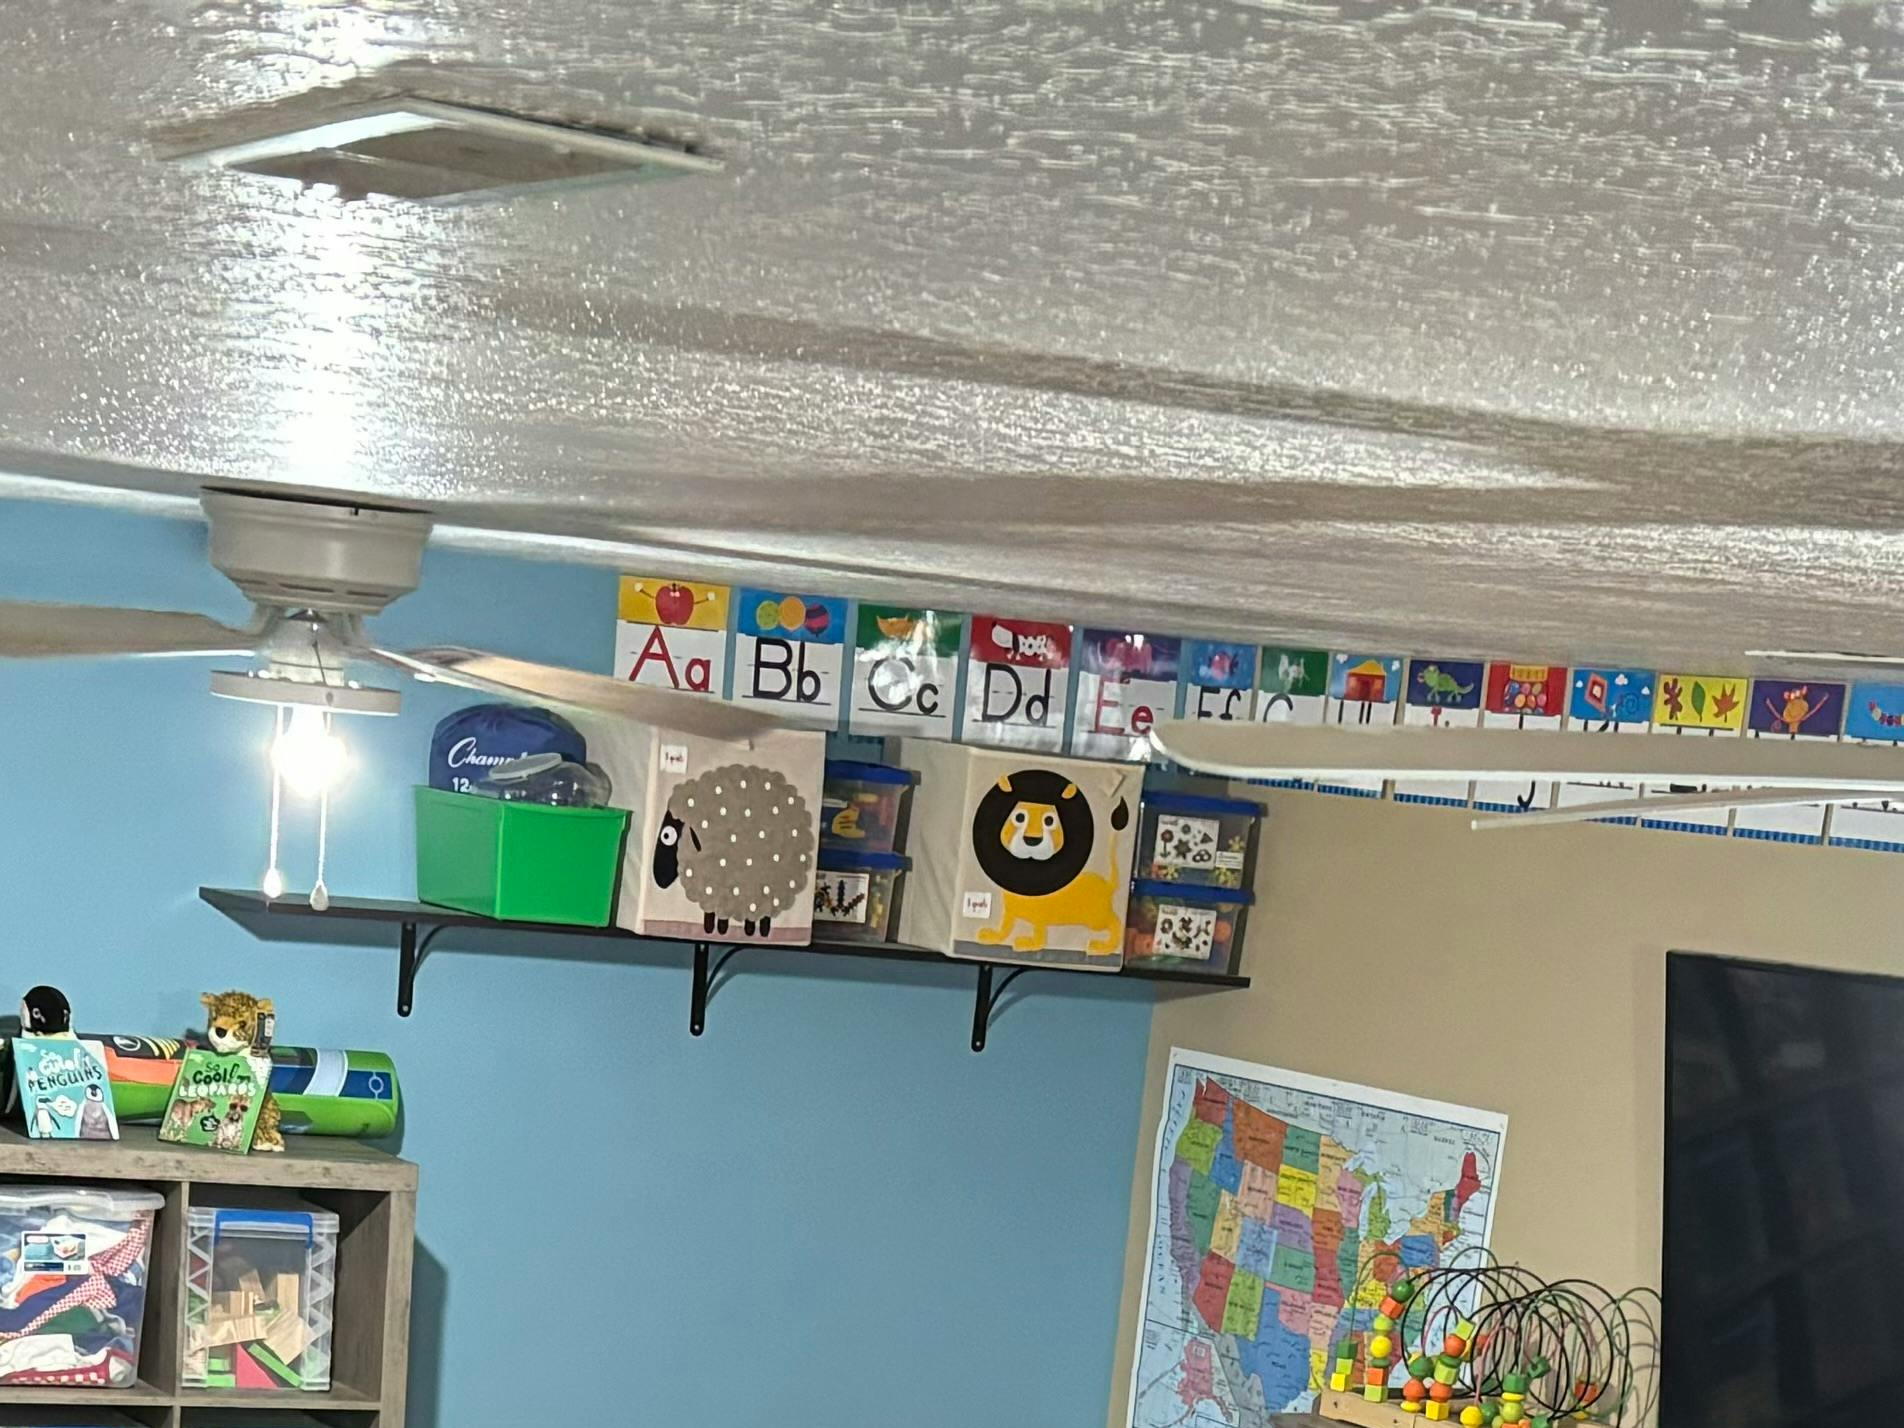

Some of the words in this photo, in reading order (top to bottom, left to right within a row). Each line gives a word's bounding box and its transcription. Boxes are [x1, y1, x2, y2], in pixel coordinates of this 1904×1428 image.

[629, 624, 711, 692] Aa
[754, 637, 822, 703] Bb
[867, 657, 939, 716] Cc
[982, 664, 1050, 726] Dd
[1094, 677, 1154, 735] Ee
[28, 1061, 102, 1092] PENGUINS
[179, 1083, 256, 1097] LEOPARDS
[193, 1063, 240, 1084] Cool!
